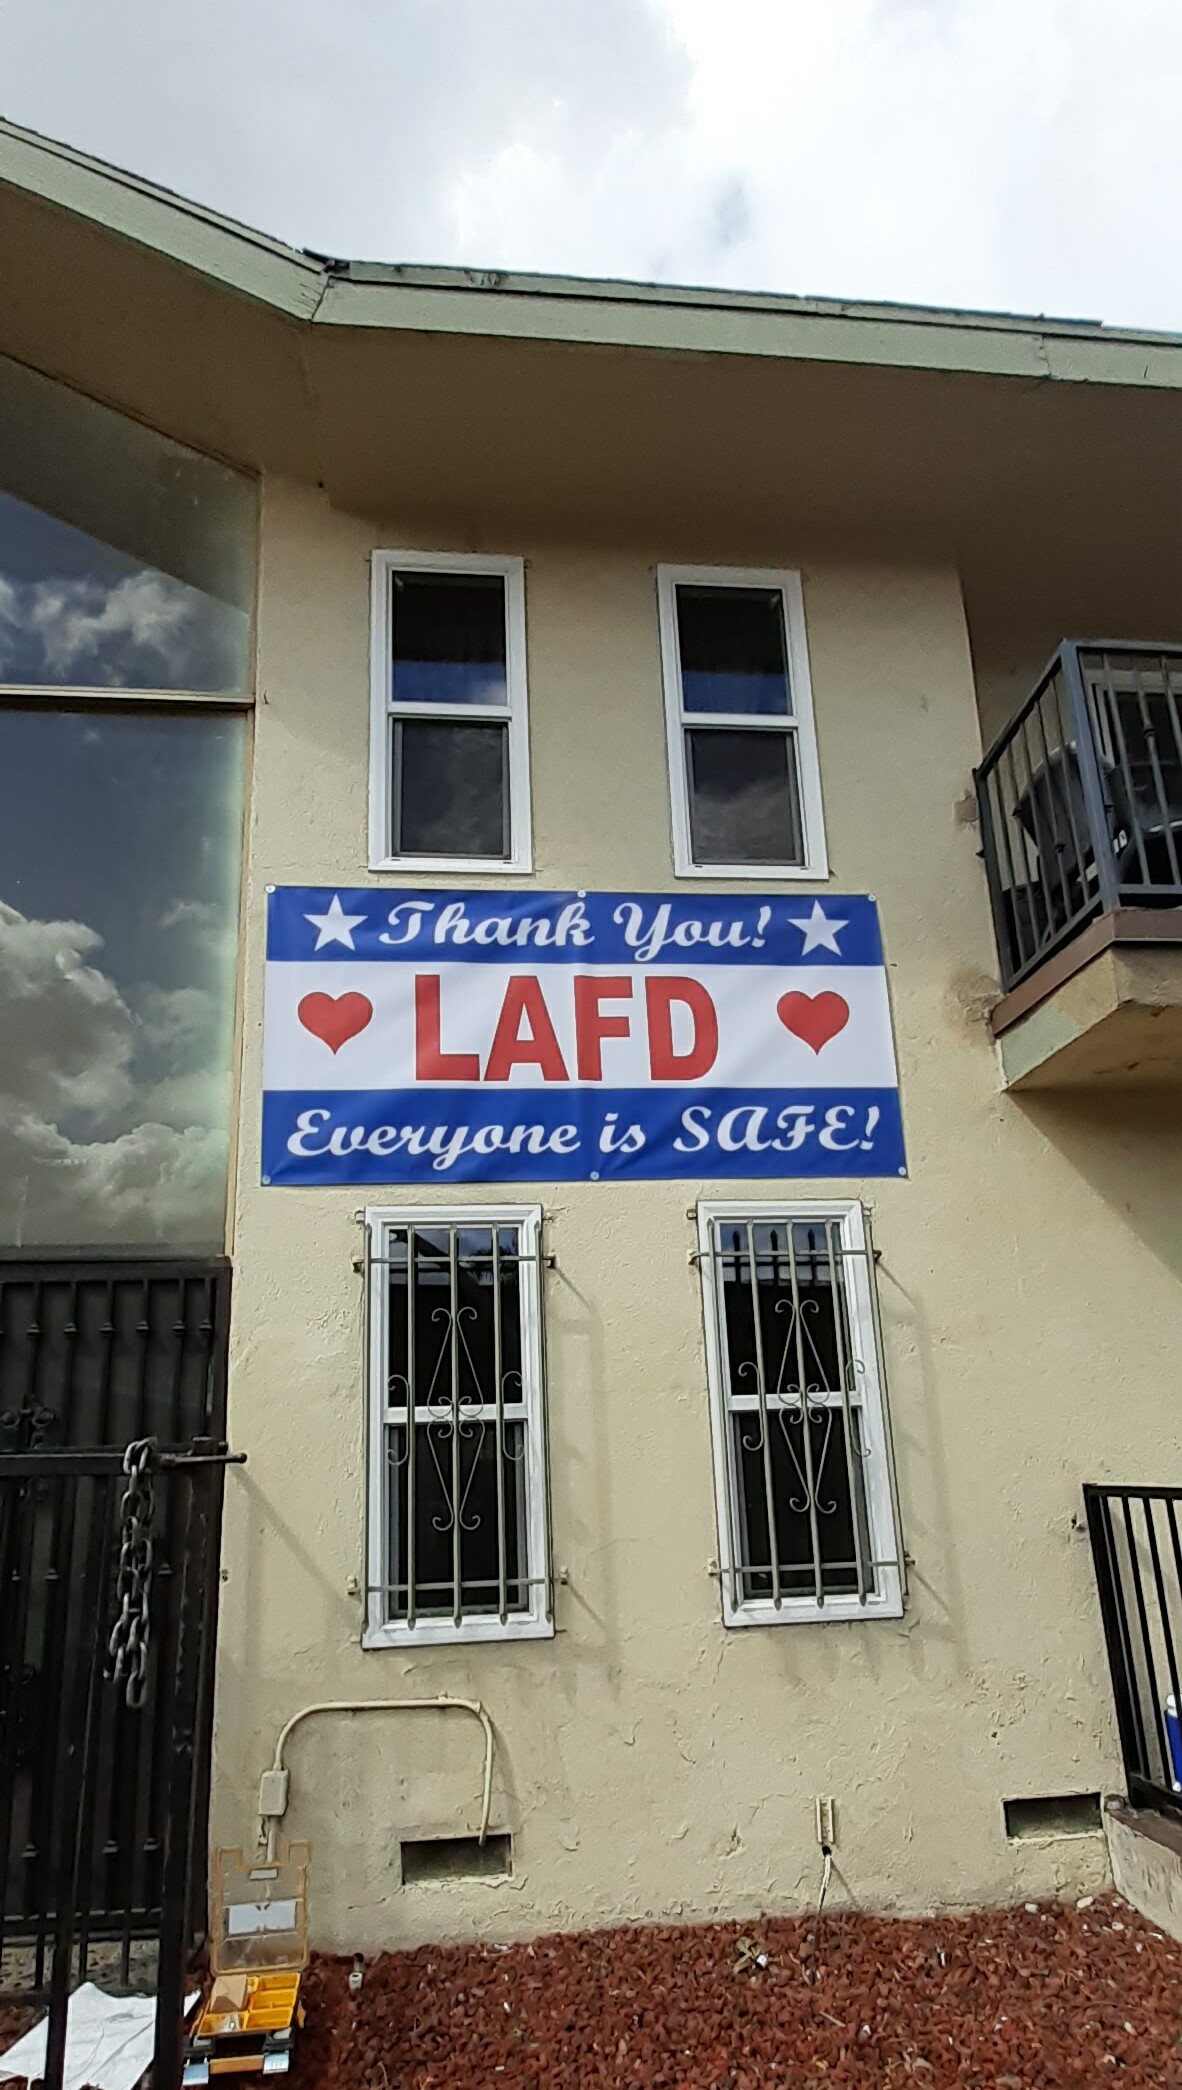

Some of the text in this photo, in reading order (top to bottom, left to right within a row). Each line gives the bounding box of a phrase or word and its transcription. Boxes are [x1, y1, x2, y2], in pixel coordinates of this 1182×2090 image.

[378, 900, 772, 961] Thank You!
[414, 974, 719, 1081] LAFD
[287, 1105, 880, 1171] Everyone is SAFE!
